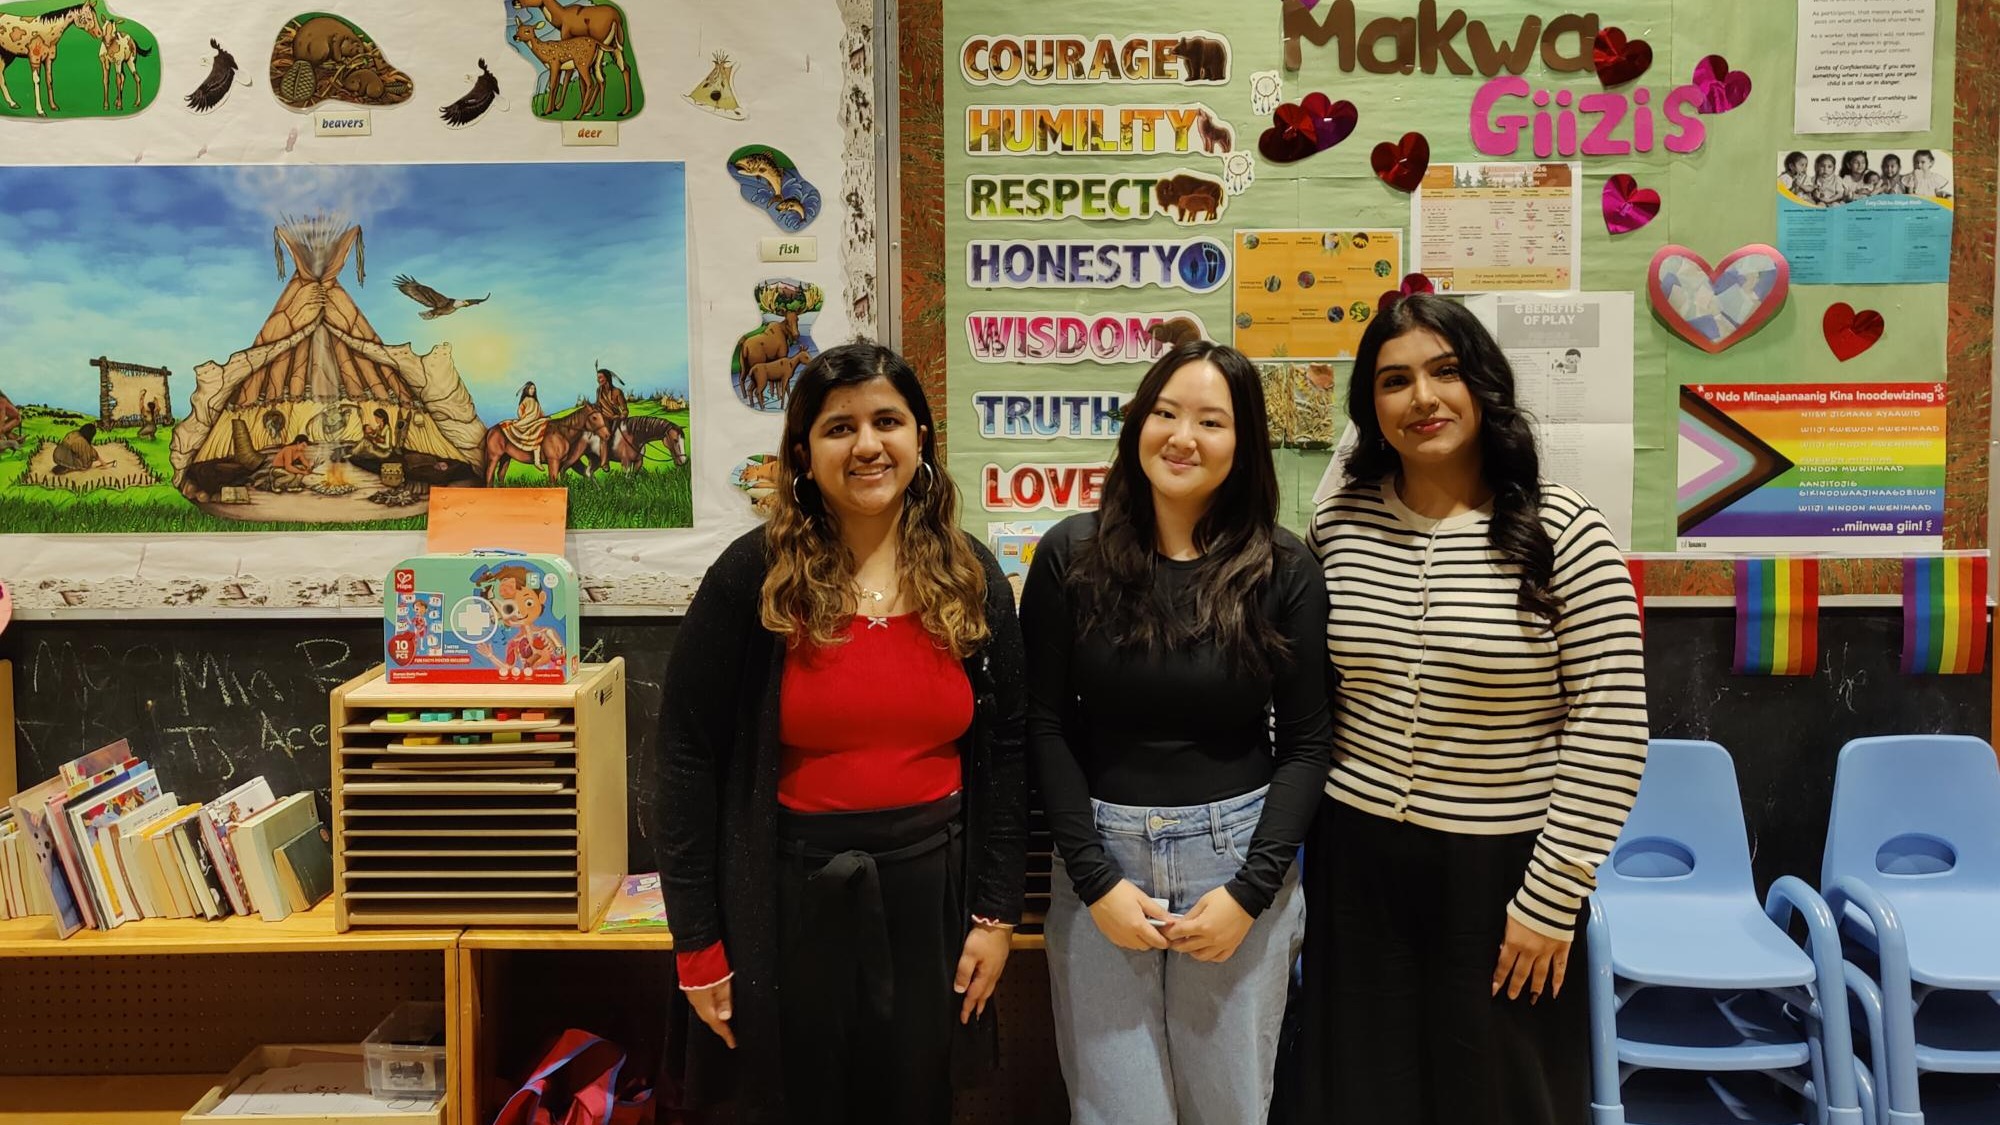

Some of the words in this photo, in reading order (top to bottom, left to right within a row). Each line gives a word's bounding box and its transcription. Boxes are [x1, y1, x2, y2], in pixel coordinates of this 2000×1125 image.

[1282, 0, 1600, 77] Makwa
[963, 39, 1179, 81] COURAGE
[322, 118, 364, 129] beavers
[577, 128, 602, 139] deer
[968, 108, 1201, 152] HUMILITY
[1470, 76, 1706, 157] Giizis
[971, 178, 1158, 217] RESPECT
[779, 243, 800, 256] fish
[971, 243, 1182, 285] HONESTY
[1514, 304, 1523, 314] 6
[1525, 303, 1585, 314] BENEFITS
[1523, 315, 1540, 325] OF
[1542, 314, 1576, 325] PLAY
[969, 315, 1166, 360] WISDOM
[976, 395, 1121, 436] TRUTH
[1716, 391, 1740, 401] Ndo
[1743, 390, 1827, 403] Minaajaanaanig
[1829, 390, 1853, 401] Kina
[1856, 390, 1934, 402] Inoodewizinag
[986, 466, 1106, 509] LOVE
[1896, 520, 1923, 534] giin!
[395, 640, 409, 650] 10
